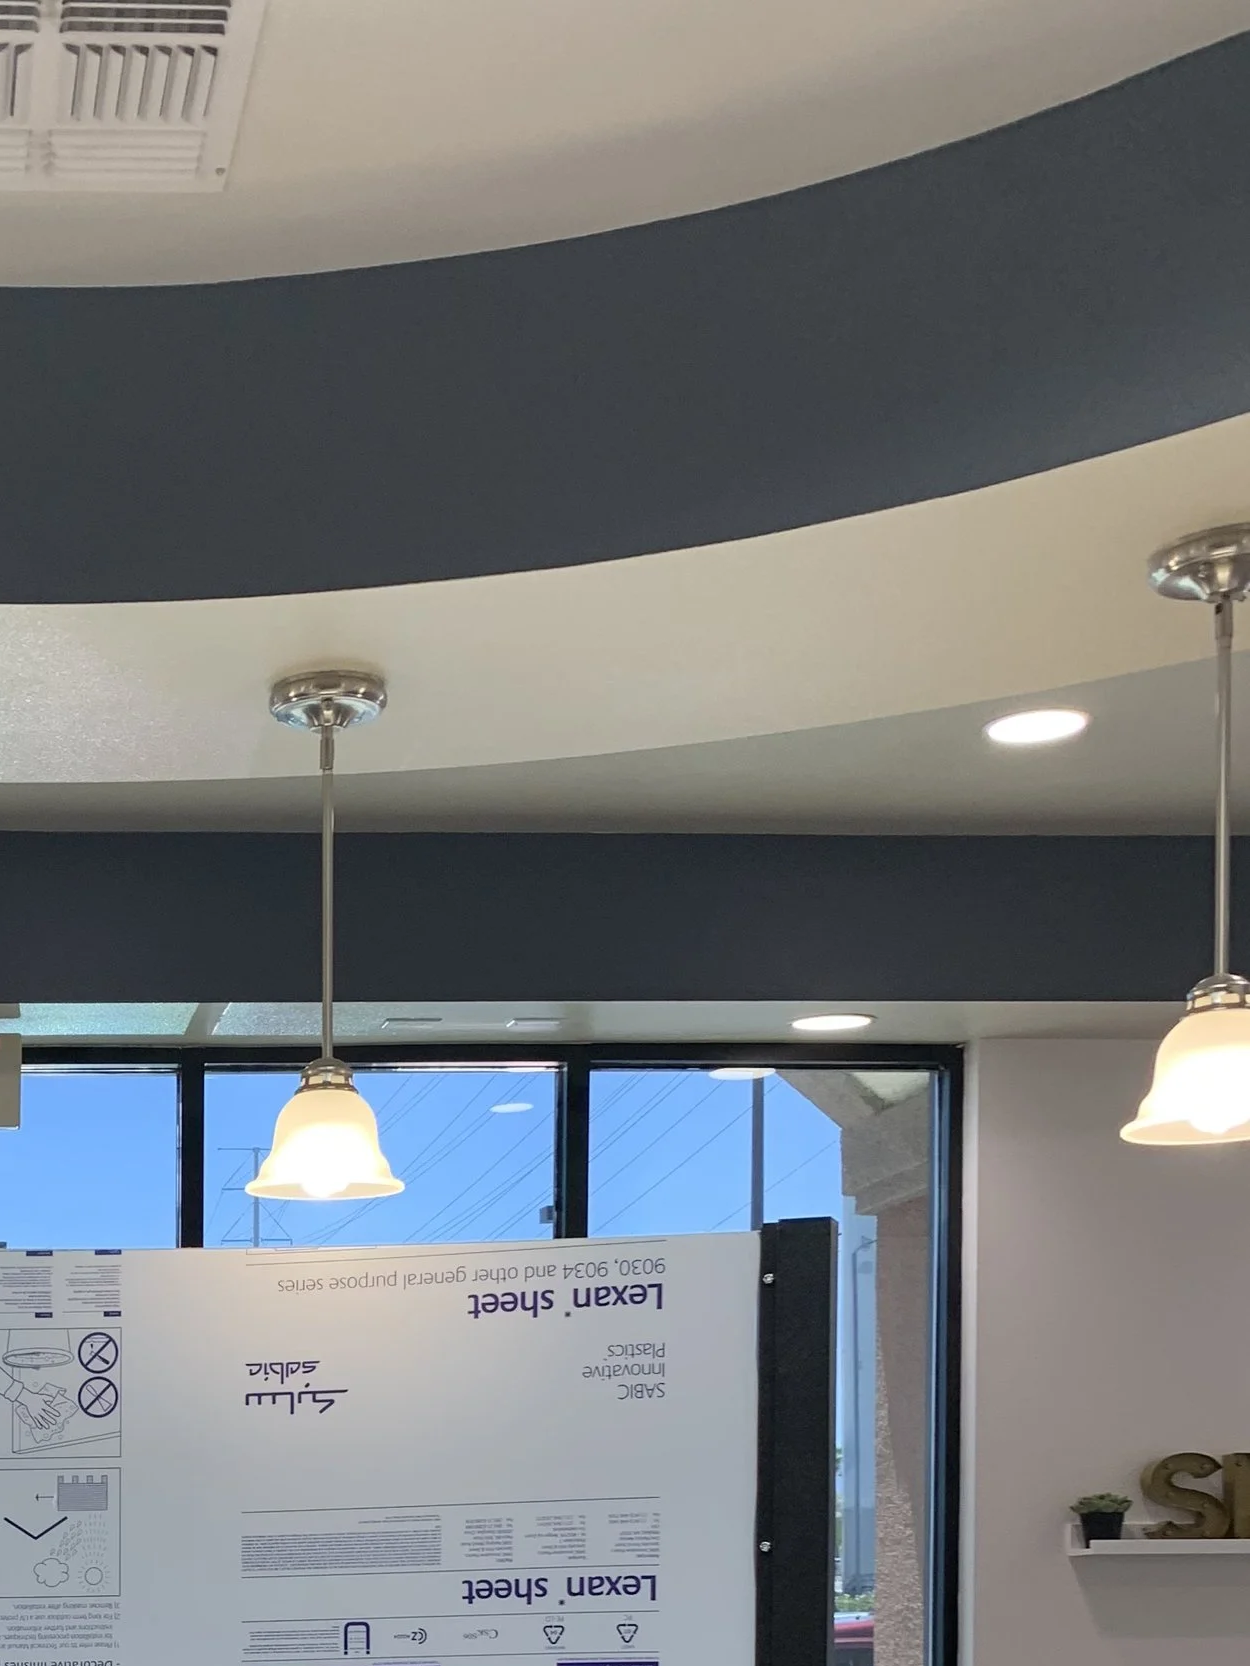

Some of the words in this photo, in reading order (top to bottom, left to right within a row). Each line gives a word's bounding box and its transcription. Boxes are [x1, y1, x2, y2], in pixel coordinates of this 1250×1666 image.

[472, 1267, 519, 1284] other
[525, 1265, 558, 1282] and
[563, 1262, 609, 1279] 9034
[615, 1258, 666, 1276] 9030,
[278, 1279, 324, 1294] series
[329, 1271, 398, 1289] purpose
[404, 1266, 467, 1290] general
[468, 1290, 555, 1319] sheet
[582, 1360, 666, 1381] Innovative
[618, 1383, 666, 1400] SABIC
[462, 1578, 549, 1605] sheet
